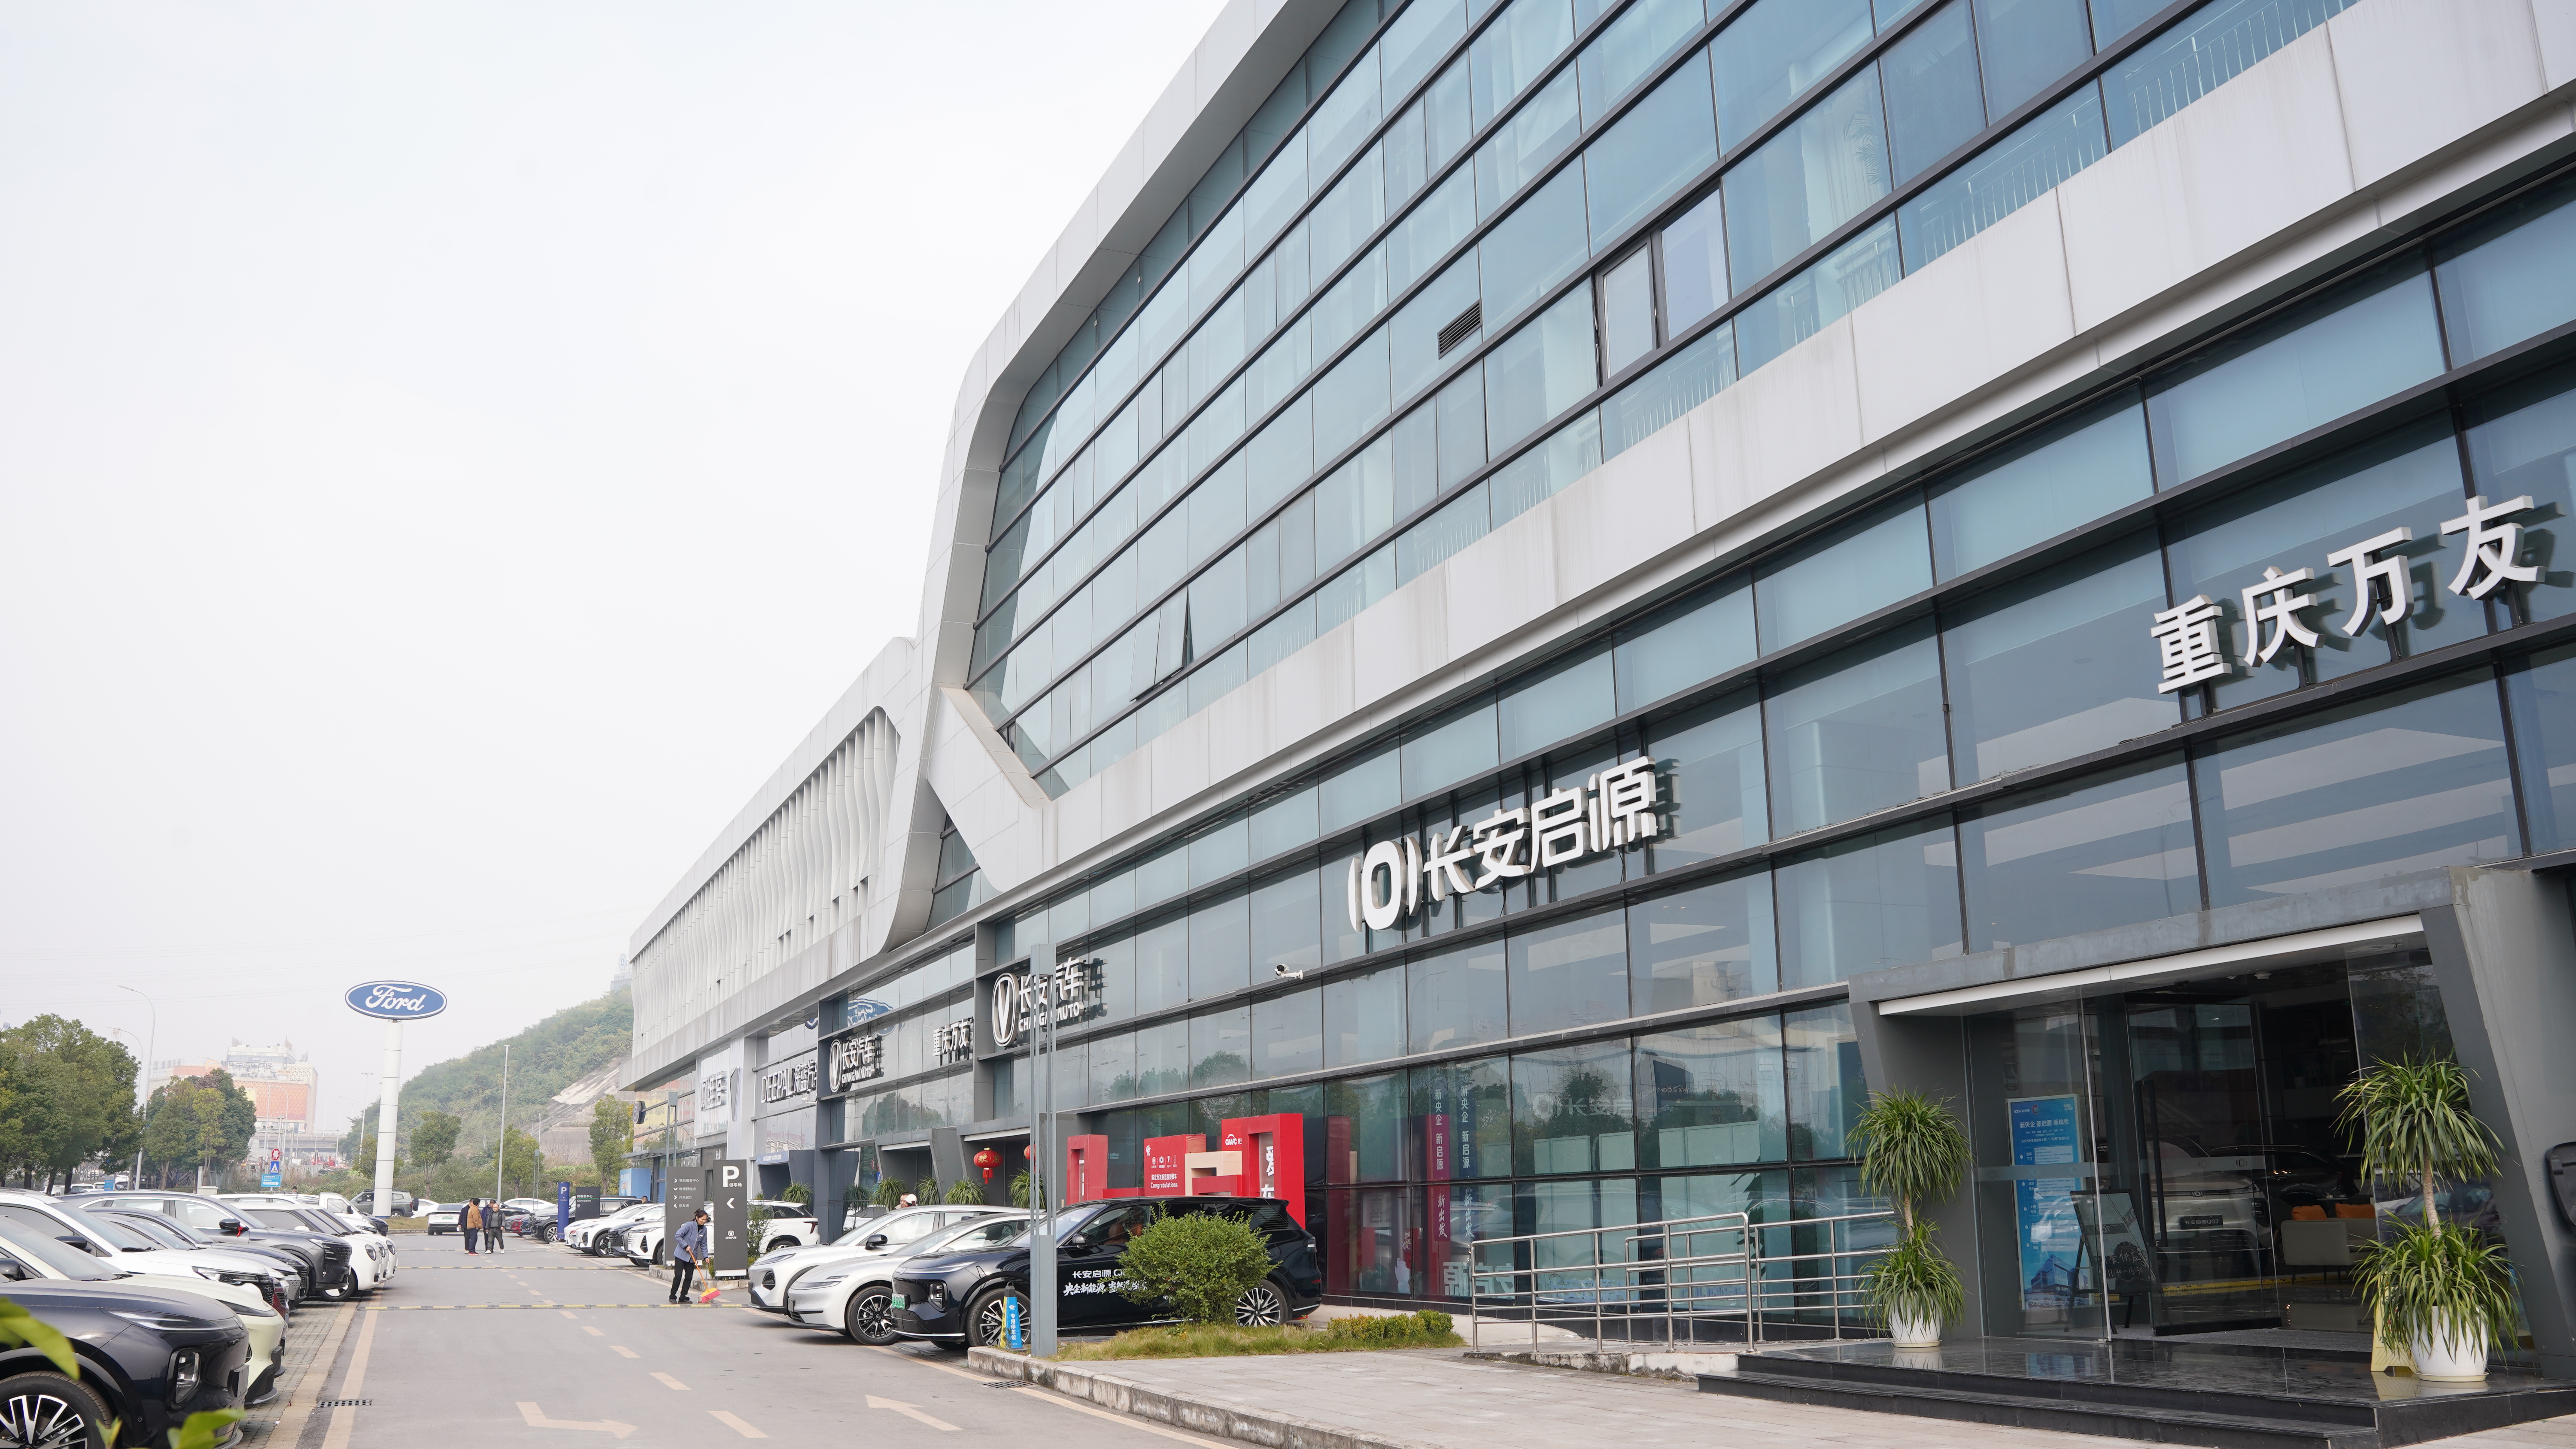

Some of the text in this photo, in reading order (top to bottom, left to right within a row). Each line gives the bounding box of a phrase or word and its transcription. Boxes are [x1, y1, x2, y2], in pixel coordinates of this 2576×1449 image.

[2151, 495, 2546, 694] 重庆万友
[1423, 756, 1657, 901] 长安启源
[365, 985, 427, 1011] Ford
[1057, 1002, 1082, 1022] AUTO
[842, 1035, 874, 1070] 长安汽车
[933, 1019, 969, 1056] 重庆万友
[761, 1057, 817, 1103] DEEPAL 深蓝汽
[841, 1067, 872, 1084] CHANGAN AUTO
[1461, 1085, 1469, 1123] 新央企
[273, 1150, 279, 1159] 停
[1462, 1131, 1470, 1169] 新启源
[723, 1166, 739, 1188] P
[2105, 1249, 2142, 1264] 餐供应
[1072, 1269, 1112, 1279] 长安启源
